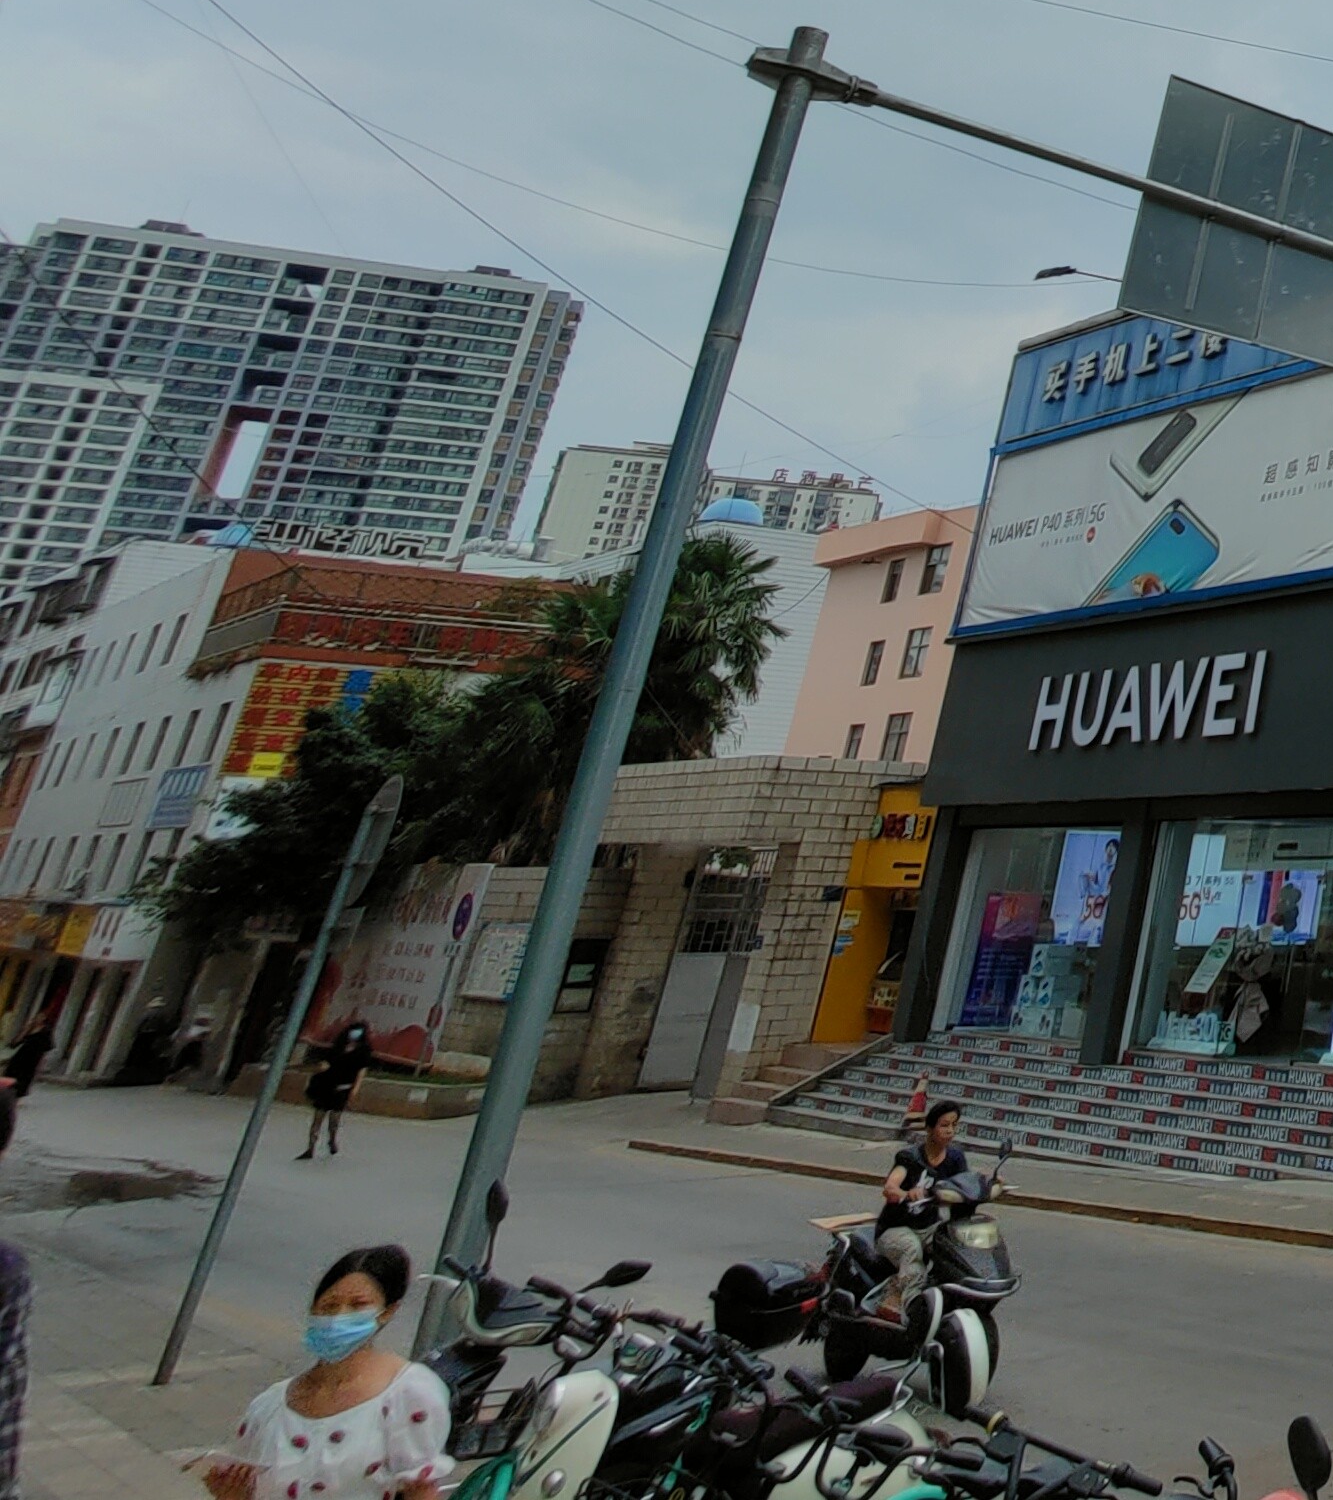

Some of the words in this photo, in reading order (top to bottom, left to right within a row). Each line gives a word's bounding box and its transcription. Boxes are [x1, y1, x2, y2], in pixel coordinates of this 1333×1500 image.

[988, 517, 1040, 547] HUAWEI
[1040, 511, 1063, 534] P40
[1088, 502, 1108, 524] 5G
[1028, 649, 1269, 752] HUAWEI
